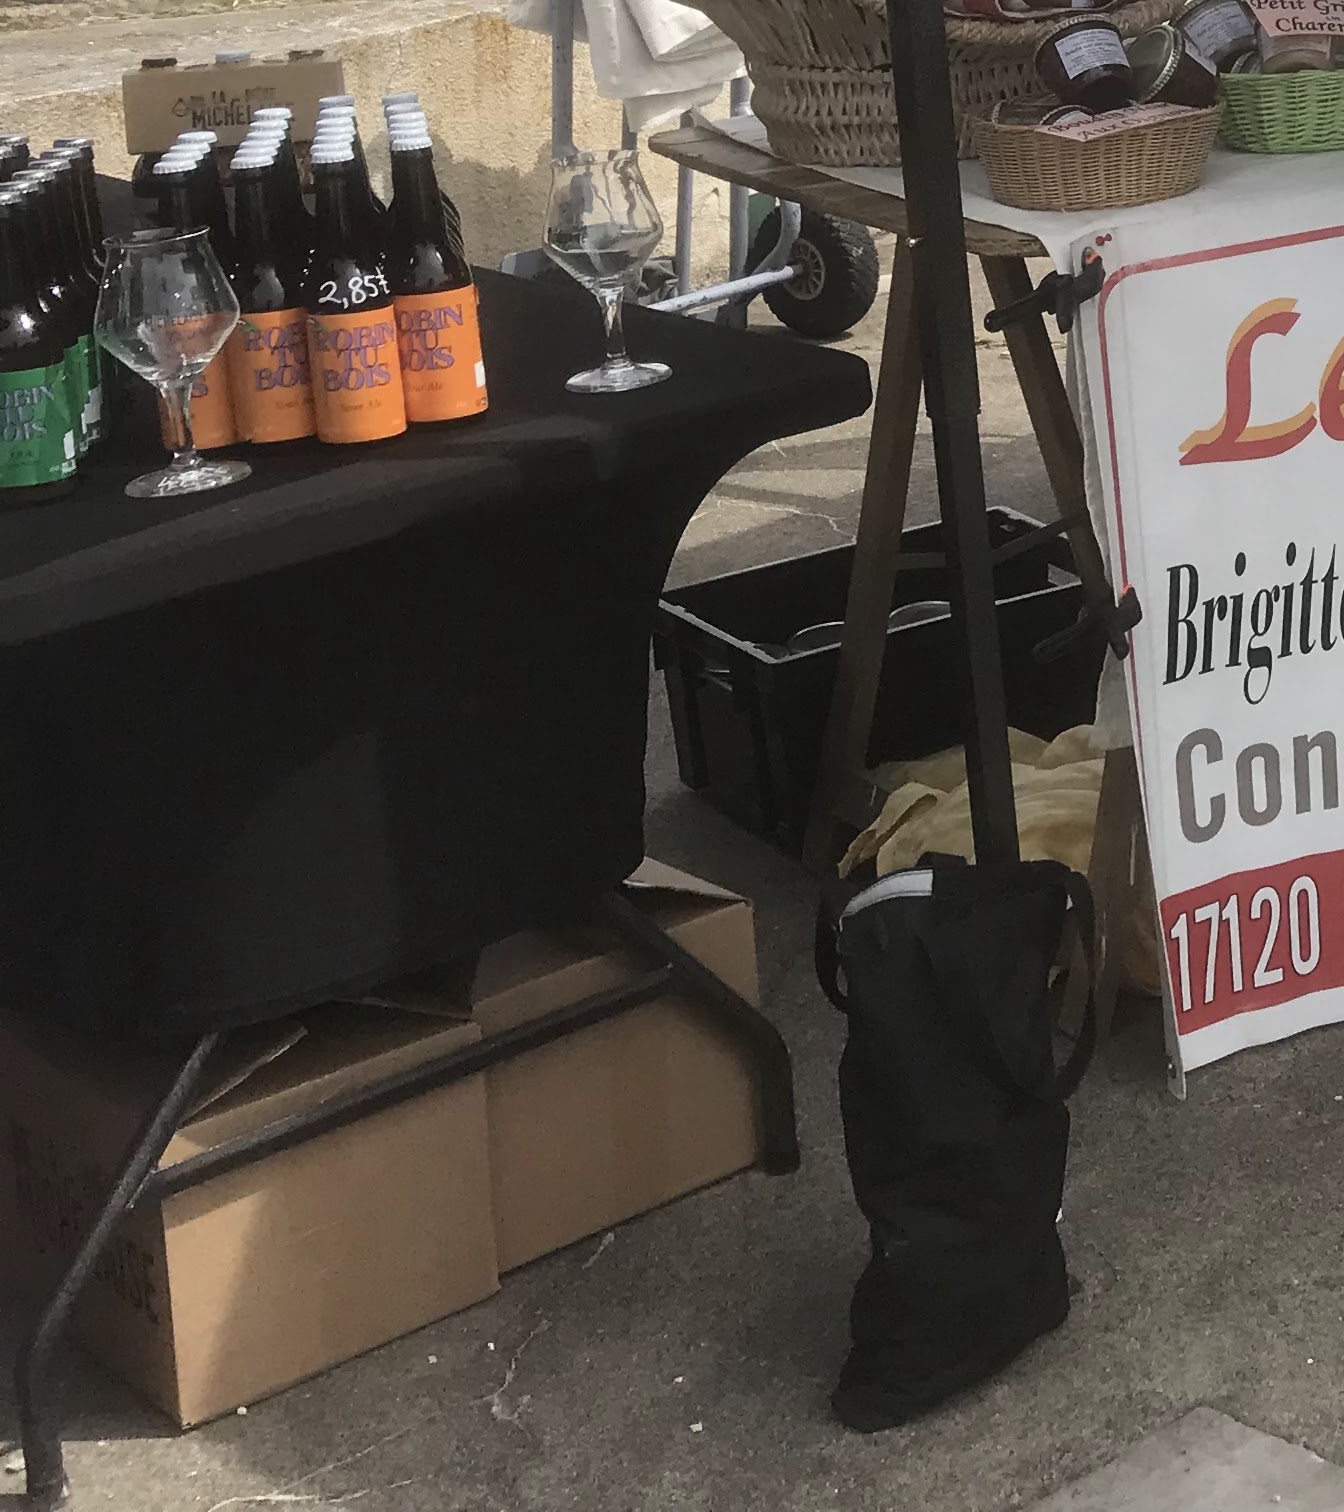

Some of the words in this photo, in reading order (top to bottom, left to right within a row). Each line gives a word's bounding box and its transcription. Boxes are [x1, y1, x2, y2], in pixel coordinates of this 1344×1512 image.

[397, 303, 464, 331] OBIN
[312, 320, 396, 352] ROBIN
[336, 343, 378, 369] TU
[322, 362, 392, 392] BOIS
[0, 385, 55, 407] OBIN
[0, 419, 48, 441] OIS
[1170, 875, 1320, 1012] 17120
